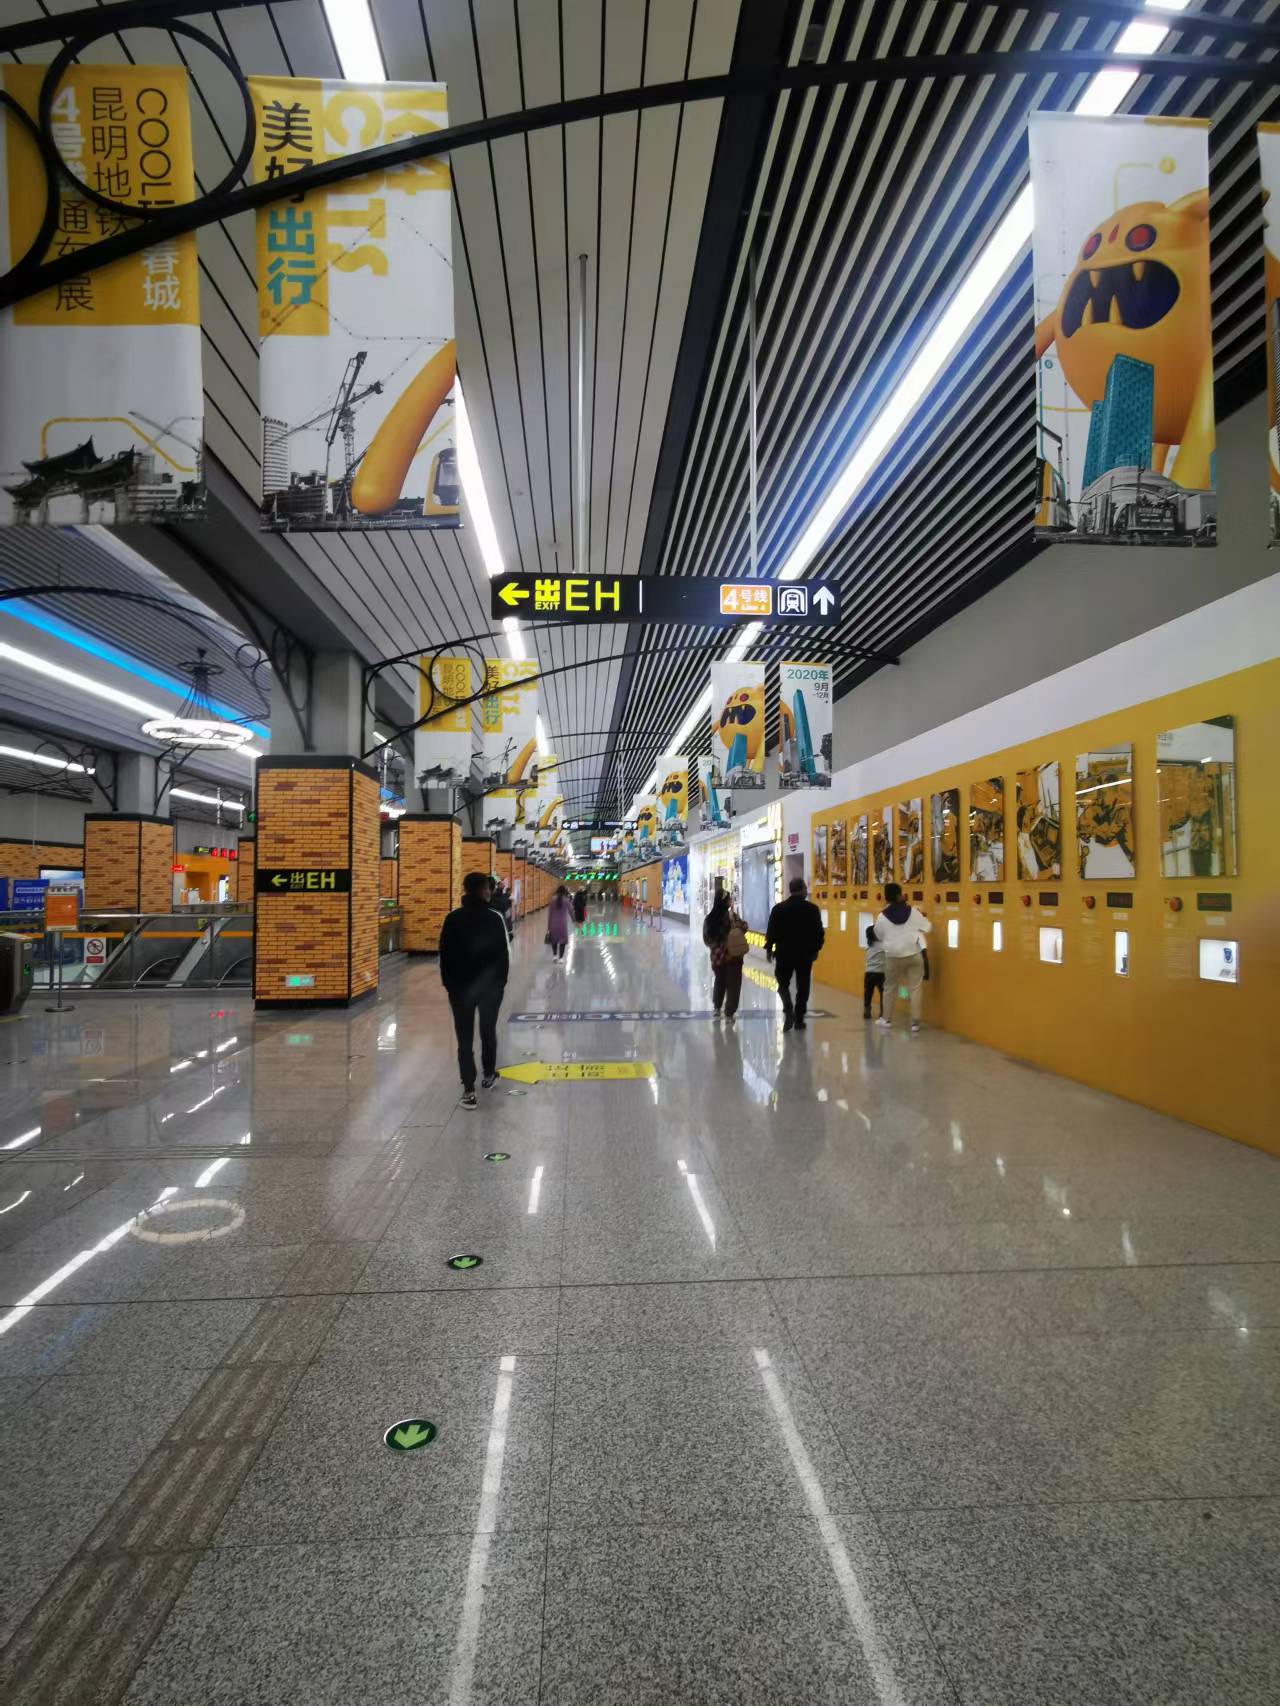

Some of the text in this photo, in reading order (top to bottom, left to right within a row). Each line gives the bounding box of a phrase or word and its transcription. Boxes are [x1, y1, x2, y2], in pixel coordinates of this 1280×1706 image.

[535, 579, 620, 611] 出 EH
[723, 589, 769, 611] 4号线
[535, 602, 560, 611] EXIT
[787, 669, 829, 681] 2020年
[814, 682, 829, 692] 9月
[290, 872, 335, 889] 出 EH
